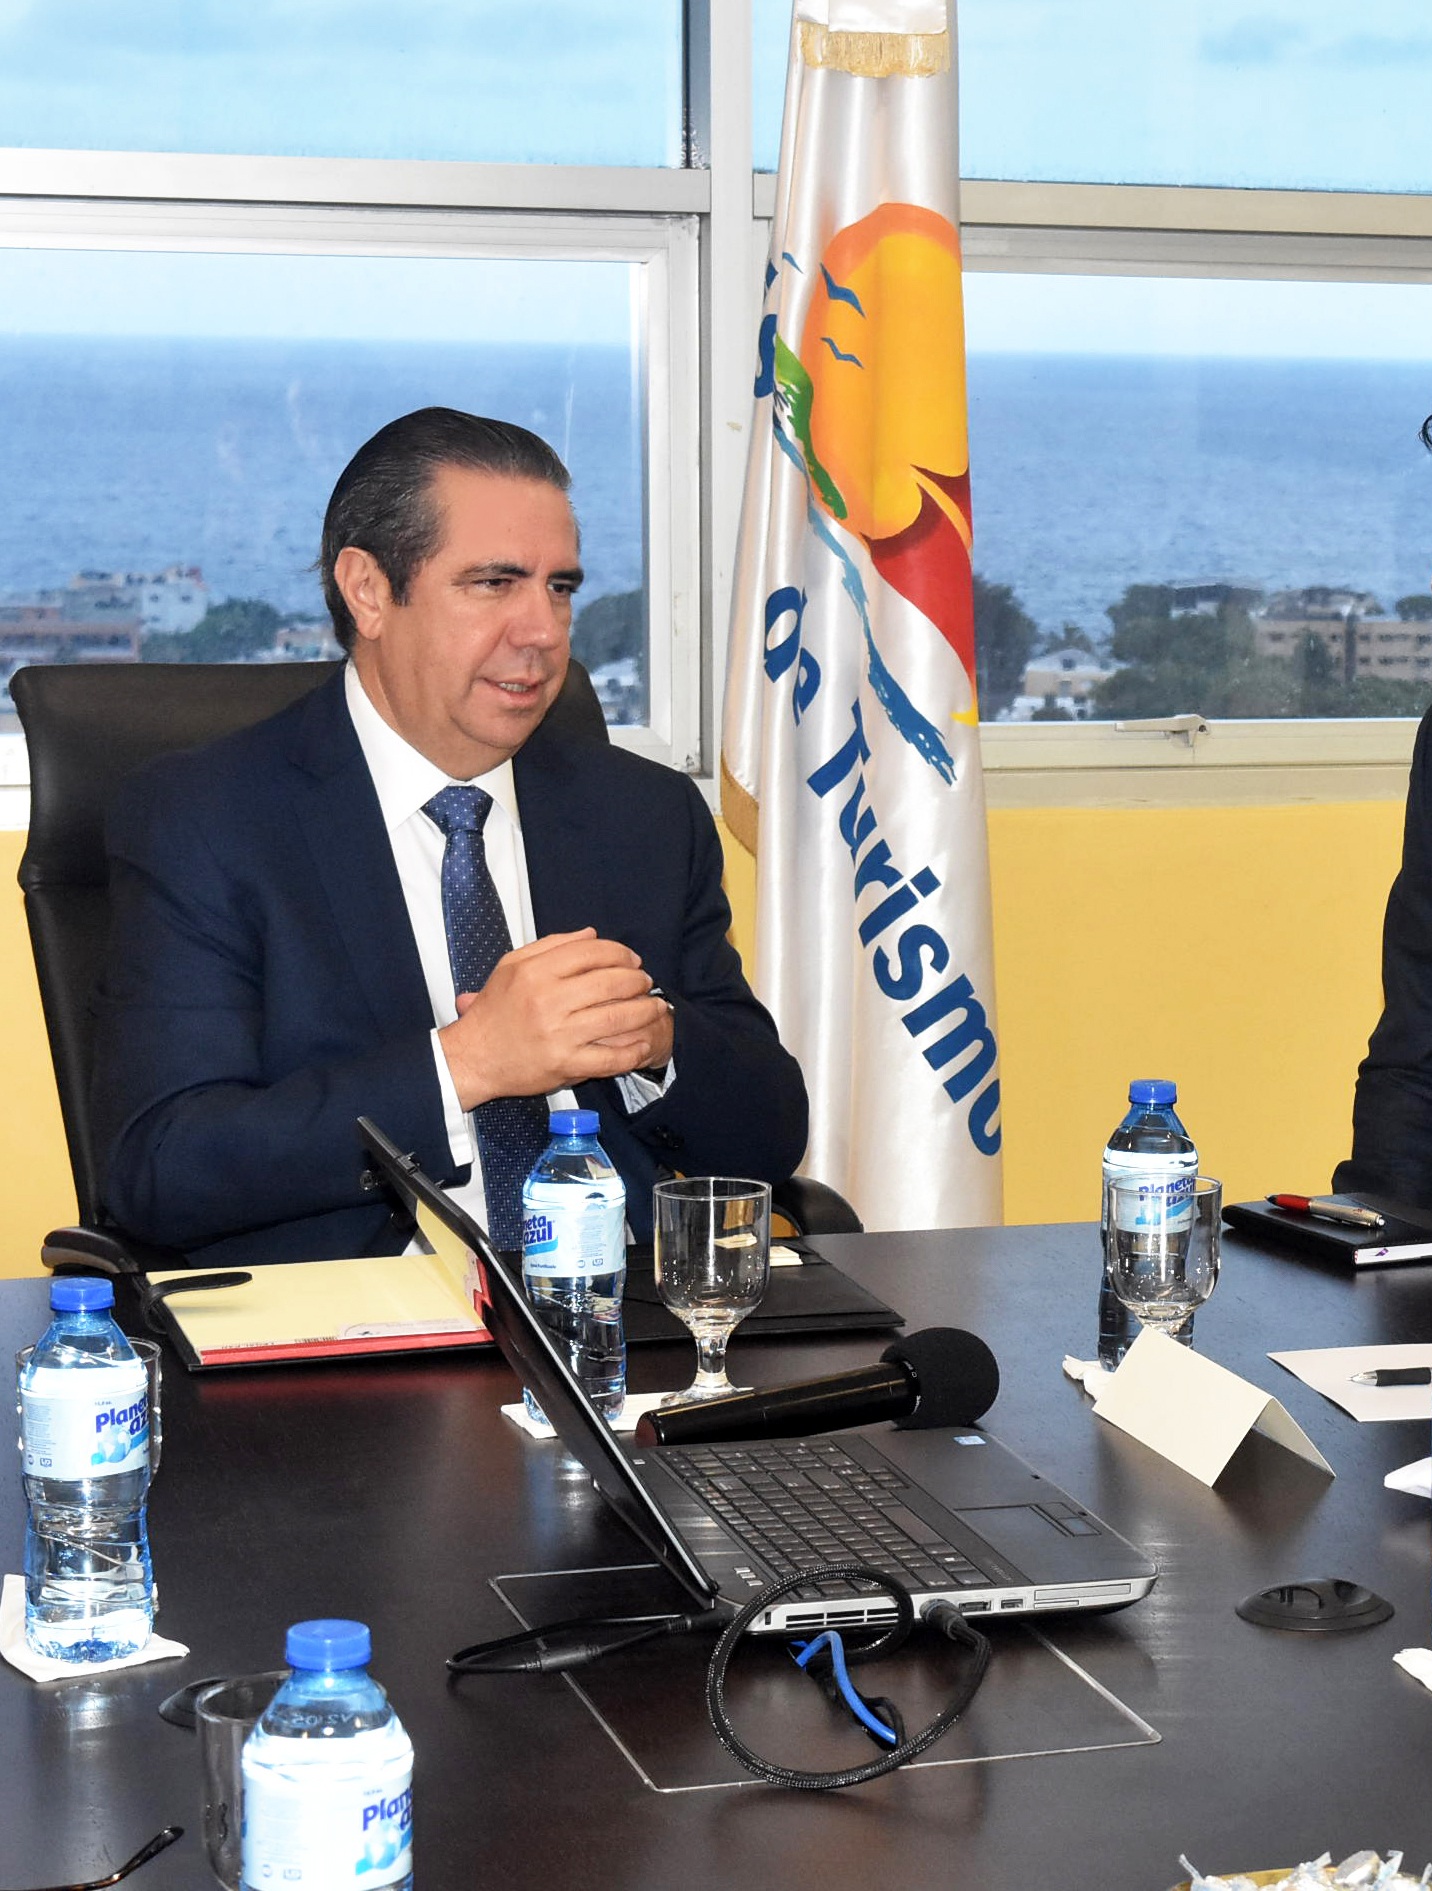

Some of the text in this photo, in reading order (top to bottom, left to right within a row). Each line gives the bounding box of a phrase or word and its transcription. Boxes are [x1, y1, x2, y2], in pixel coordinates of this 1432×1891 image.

[523, 1214, 547, 1231] neta
[523, 1220, 553, 1245] azul
[95, 1391, 149, 1434] Planet
[129, 1409, 149, 1436] az
[362, 1787, 413, 1832] Plan
